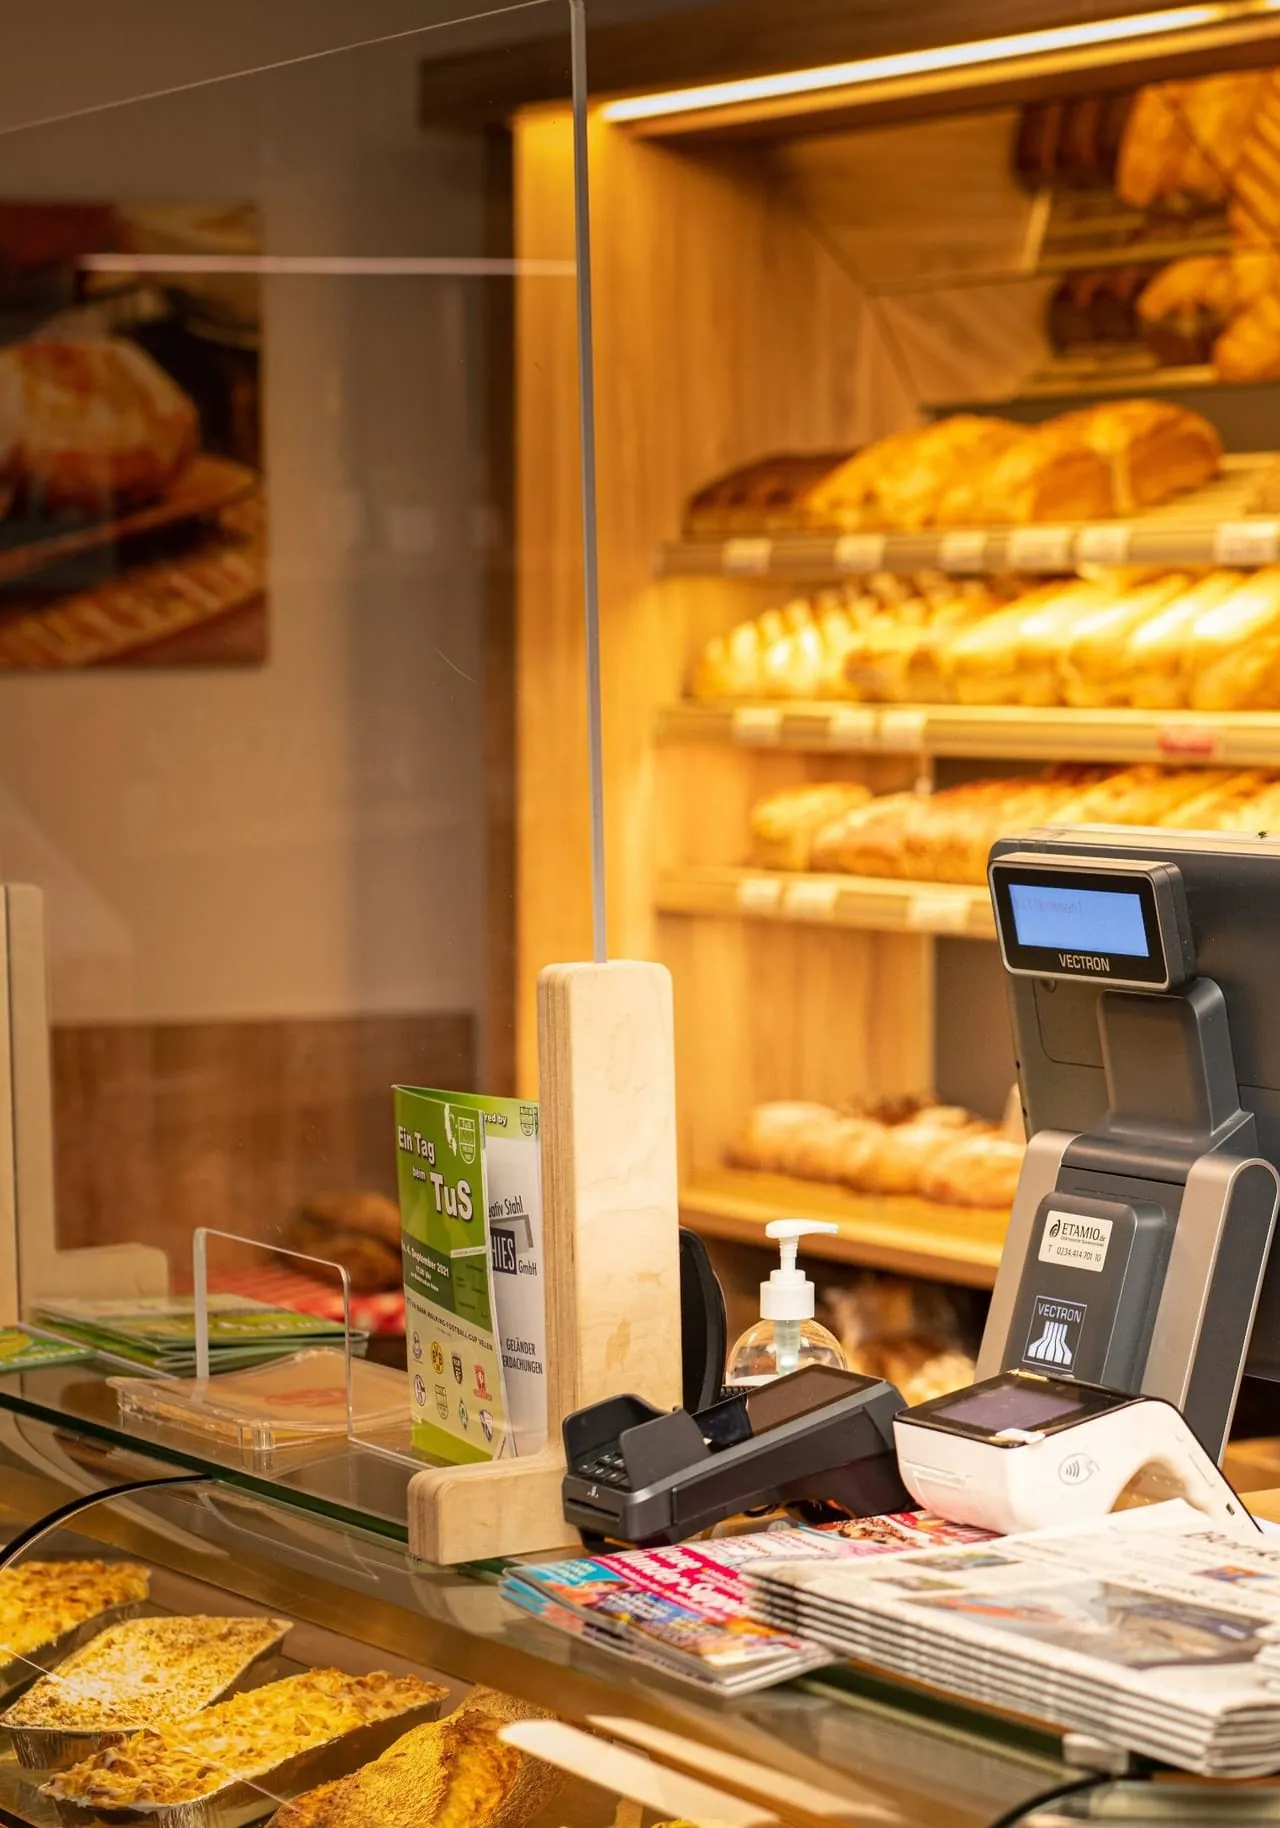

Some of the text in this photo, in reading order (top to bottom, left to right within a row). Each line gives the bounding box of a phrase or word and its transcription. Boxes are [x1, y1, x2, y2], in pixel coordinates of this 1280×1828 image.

[1058, 953, 1110, 972] VECTRON
[398, 1126, 413, 1152] Ein
[414, 1132, 436, 1166] Tag
[429, 1171, 474, 1221] TuS
[504, 1194, 524, 1216] Stahl
[518, 1259, 537, 1276] GmbH
[1037, 1302, 1082, 1323] VECTRON
[505, 1336, 536, 1356] GELÄNDER
